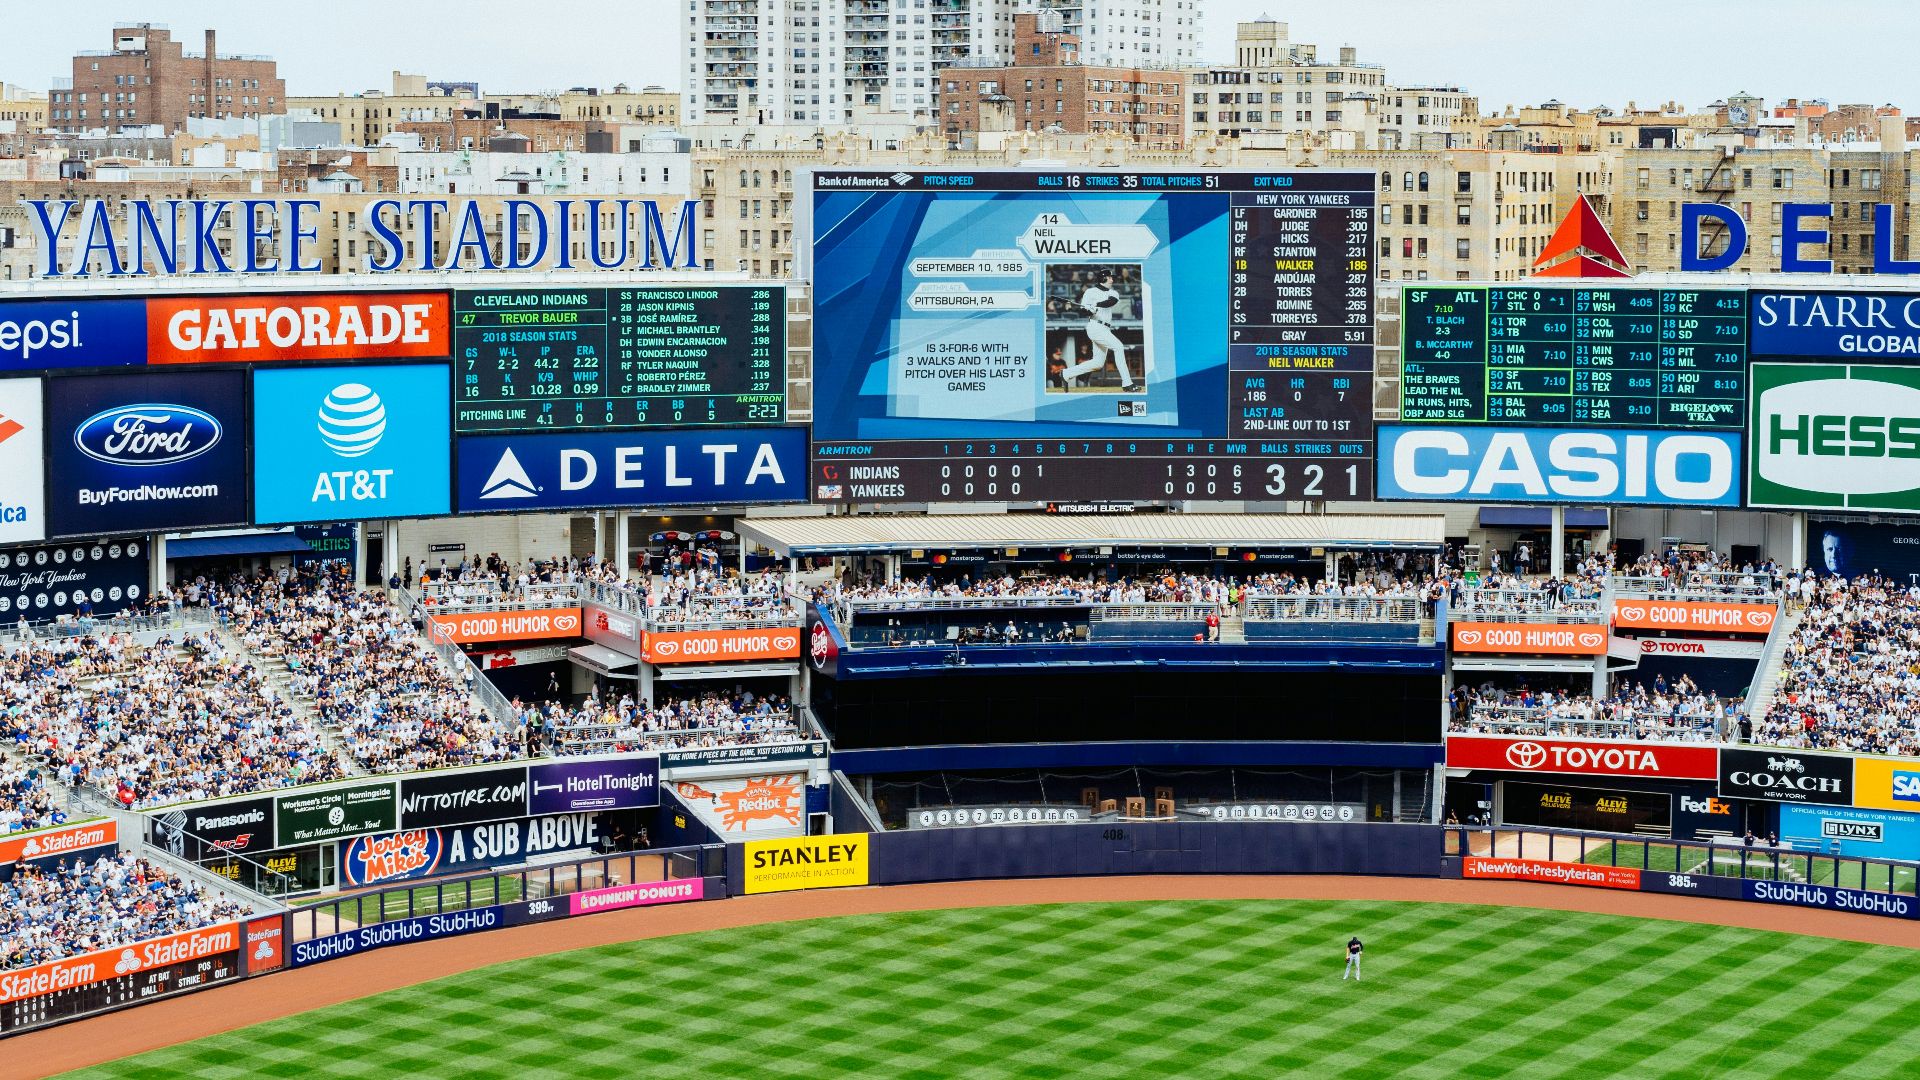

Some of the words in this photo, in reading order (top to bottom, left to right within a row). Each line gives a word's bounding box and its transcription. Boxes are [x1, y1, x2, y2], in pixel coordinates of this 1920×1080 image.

[818, 176, 841, 186] Bank
[842, 176, 851, 186] of
[852, 176, 889, 186] America
[1038, 176, 1063, 186] BALLS
[1066, 176, 1080, 188] 16
[1086, 176, 1119, 186] STRIKES
[1122, 176, 1138, 188] 35
[1256, 195, 1278, 204] NEW
[1281, 195, 1306, 204] YORK
[1308, 195, 1350, 204] YANKEES
[1042, 214, 1058, 224] 14
[24, 199, 323, 276] YANKEE
[363, 197, 703, 272] STADIUM
[1034, 229, 1056, 238] NEIL
[1681, 202, 1920, 274] DEL
[1035, 240, 1112, 254] WALKER
[916, 263, 975, 272] SEPTEMBER
[978, 263, 994, 274] 10,
[997, 262, 1023, 272] 1985
[474, 295, 539, 306] CLEVELAND
[542, 294, 588, 305] INDIANS
[637, 291, 685, 300] FRANCISCO
[687, 290, 718, 300] LINDOR
[914, 296, 980, 306] PITTSBURGH,
[981, 296, 994, 306] PA
[1411, 292, 1429, 303] SF
[1455, 292, 1479, 303] ATL
[1434, 305, 1453, 313] 7:10
[1758, 294, 1896, 329] STARR
[462, 314, 476, 325] 47
[500, 314, 540, 324] TREVOR
[543, 312, 578, 323] BAUER
[168, 304, 431, 350] GATORADE
[483, 332, 506, 342] 2018
[510, 332, 545, 342] SEASON
[548, 331, 578, 341] STATS
[926, 344, 936, 352] IS
[982, 344, 1009, 352] WITH
[907, 357, 914, 366] 3
[917, 357, 955, 366] WALKS
[958, 357, 981, 366] AND
[984, 357, 990, 365] 1
[994, 356, 1011, 365] HIT
[1014, 356, 1028, 365] BY
[906, 370, 935, 378] PITCH
[938, 370, 966, 378] OVER
[970, 369, 986, 378] HIS
[990, 369, 1015, 378] LAST
[1018, 369, 1026, 378] 3
[1405, 376, 1423, 384] THE
[1426, 376, 1460, 384] BRAVES
[948, 382, 986, 391] GAMES
[1670, 403, 1734, 414] BIGELOW
[1687, 412, 1715, 422] TEA
[104, 414, 191, 456] Ford
[1770, 412, 1920, 459] HESS
[560, 443, 786, 491] DELTA
[1393, 430, 1733, 500] CASIO
[850, 465, 900, 480] INDIANS
[311, 469, 394, 502] AT&T
[850, 484, 905, 498] YANKEES
[79, 482, 218, 505] BuyFordNow.com
[1058, 504, 1098, 513] MITSUBISHI
[1100, 504, 1135, 512] ELECTRIC
[20, 570, 46, 592] York
[46, 569, 86, 590] Yankees
[1650, 607, 1687, 623] GOOD
[1691, 608, 1743, 626] HUMOR
[461, 619, 498, 636] GOOD
[501, 616, 550, 634] HUMOR
[683, 639, 718, 654] GOOD
[722, 636, 770, 653] HUMOR
[1486, 630, 1522, 646] GOOD
[1526, 630, 1576, 647] HUMOR
[1658, 642, 1704, 653] TOYOTA
[668, 752, 680, 761] TAKE
[682, 752, 698, 760] HOME
[702, 750, 719, 759] PIECE
[720, 750, 728, 758] OF
[728, 750, 738, 758] THE
[1550, 746, 1659, 771] TOYOTA
[1730, 771, 1842, 793] COACH
[348, 789, 390, 800] Morningside
[402, 781, 526, 815] NITTOTIRE.COM
[1540, 793, 1572, 804] ALEVE
[282, 796, 320, 810] Workmen's
[322, 794, 342, 804] Circle
[738, 797, 782, 813] RedHot
[1596, 798, 1628, 808] ALEVE
[1680, 796, 1730, 814] FedEx
[196, 809, 264, 831] Panasonic
[294, 830, 314, 840] What
[314, 828, 340, 837] Matters
[1103, 829, 1124, 841] 408
[1839, 823, 1878, 836] LYNX
[450, 830, 466, 864] A
[472, 822, 520, 860] SUB
[526, 812, 600, 854] ABOVE
[358, 829, 429, 862] Jersey
[266, 857, 296, 868] ALEVE
[754, 844, 858, 869] STANLEY
[365, 848, 430, 884] Mike's
[1478, 861, 1604, 882] NewYork-Presbyterian
[754, 870, 811, 882] PERFORMANCE
[813, 870, 822, 878] IN
[824, 867, 856, 877] ACTION
[590, 890, 638, 907] DUNKIN'
[640, 884, 692, 900] DONUTS
[1754, 882, 1828, 906] StubHub
[1834, 890, 1908, 914] StubHub
[296, 936, 356, 963] StubHub
[360, 922, 424, 948] StubHub
[430, 911, 496, 936] StubHub
[143, 930, 232, 968] StateFarm
